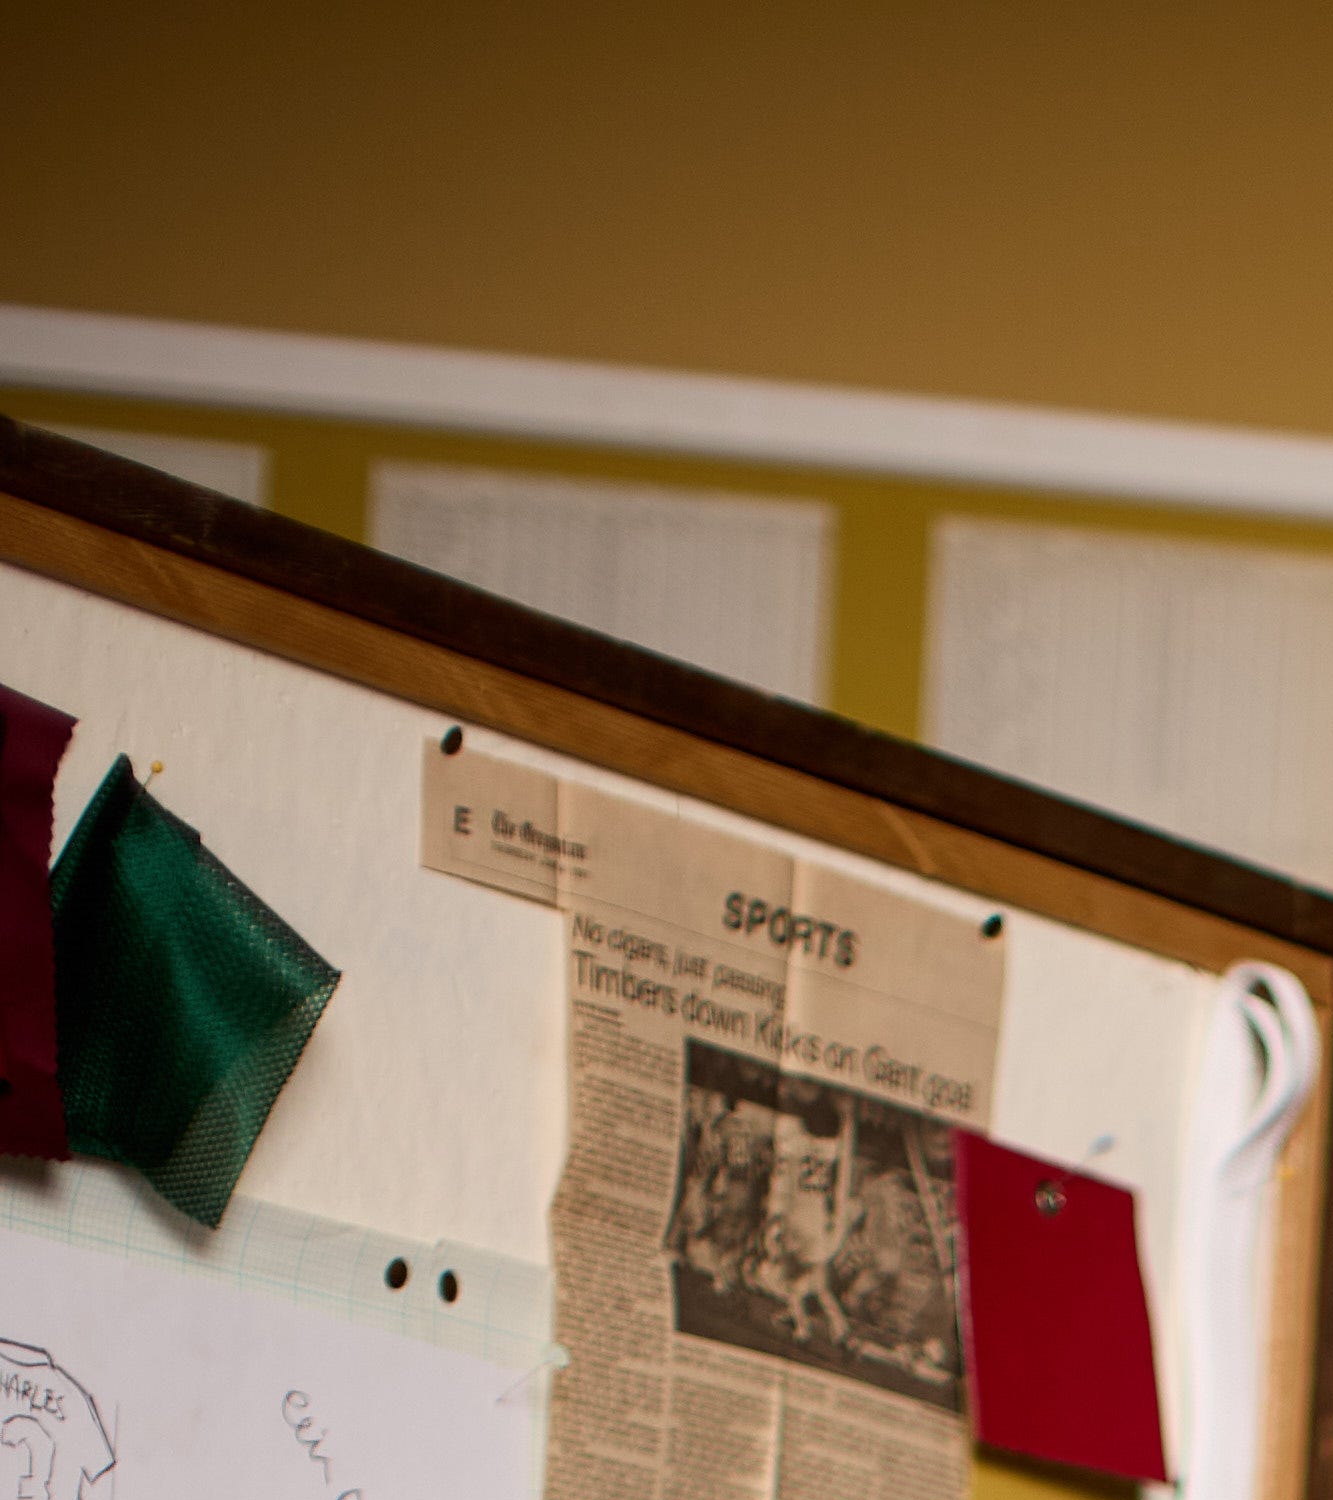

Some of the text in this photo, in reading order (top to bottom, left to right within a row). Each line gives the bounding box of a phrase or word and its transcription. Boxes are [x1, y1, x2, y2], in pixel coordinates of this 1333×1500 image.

[454, 805, 472, 835] E
[573, 913, 603, 945] No
[722, 891, 860, 968] SPORTS
[572, 949, 678, 1015] Timbers
[681, 992, 750, 1041] down
[824, 1042, 857, 1073] on
